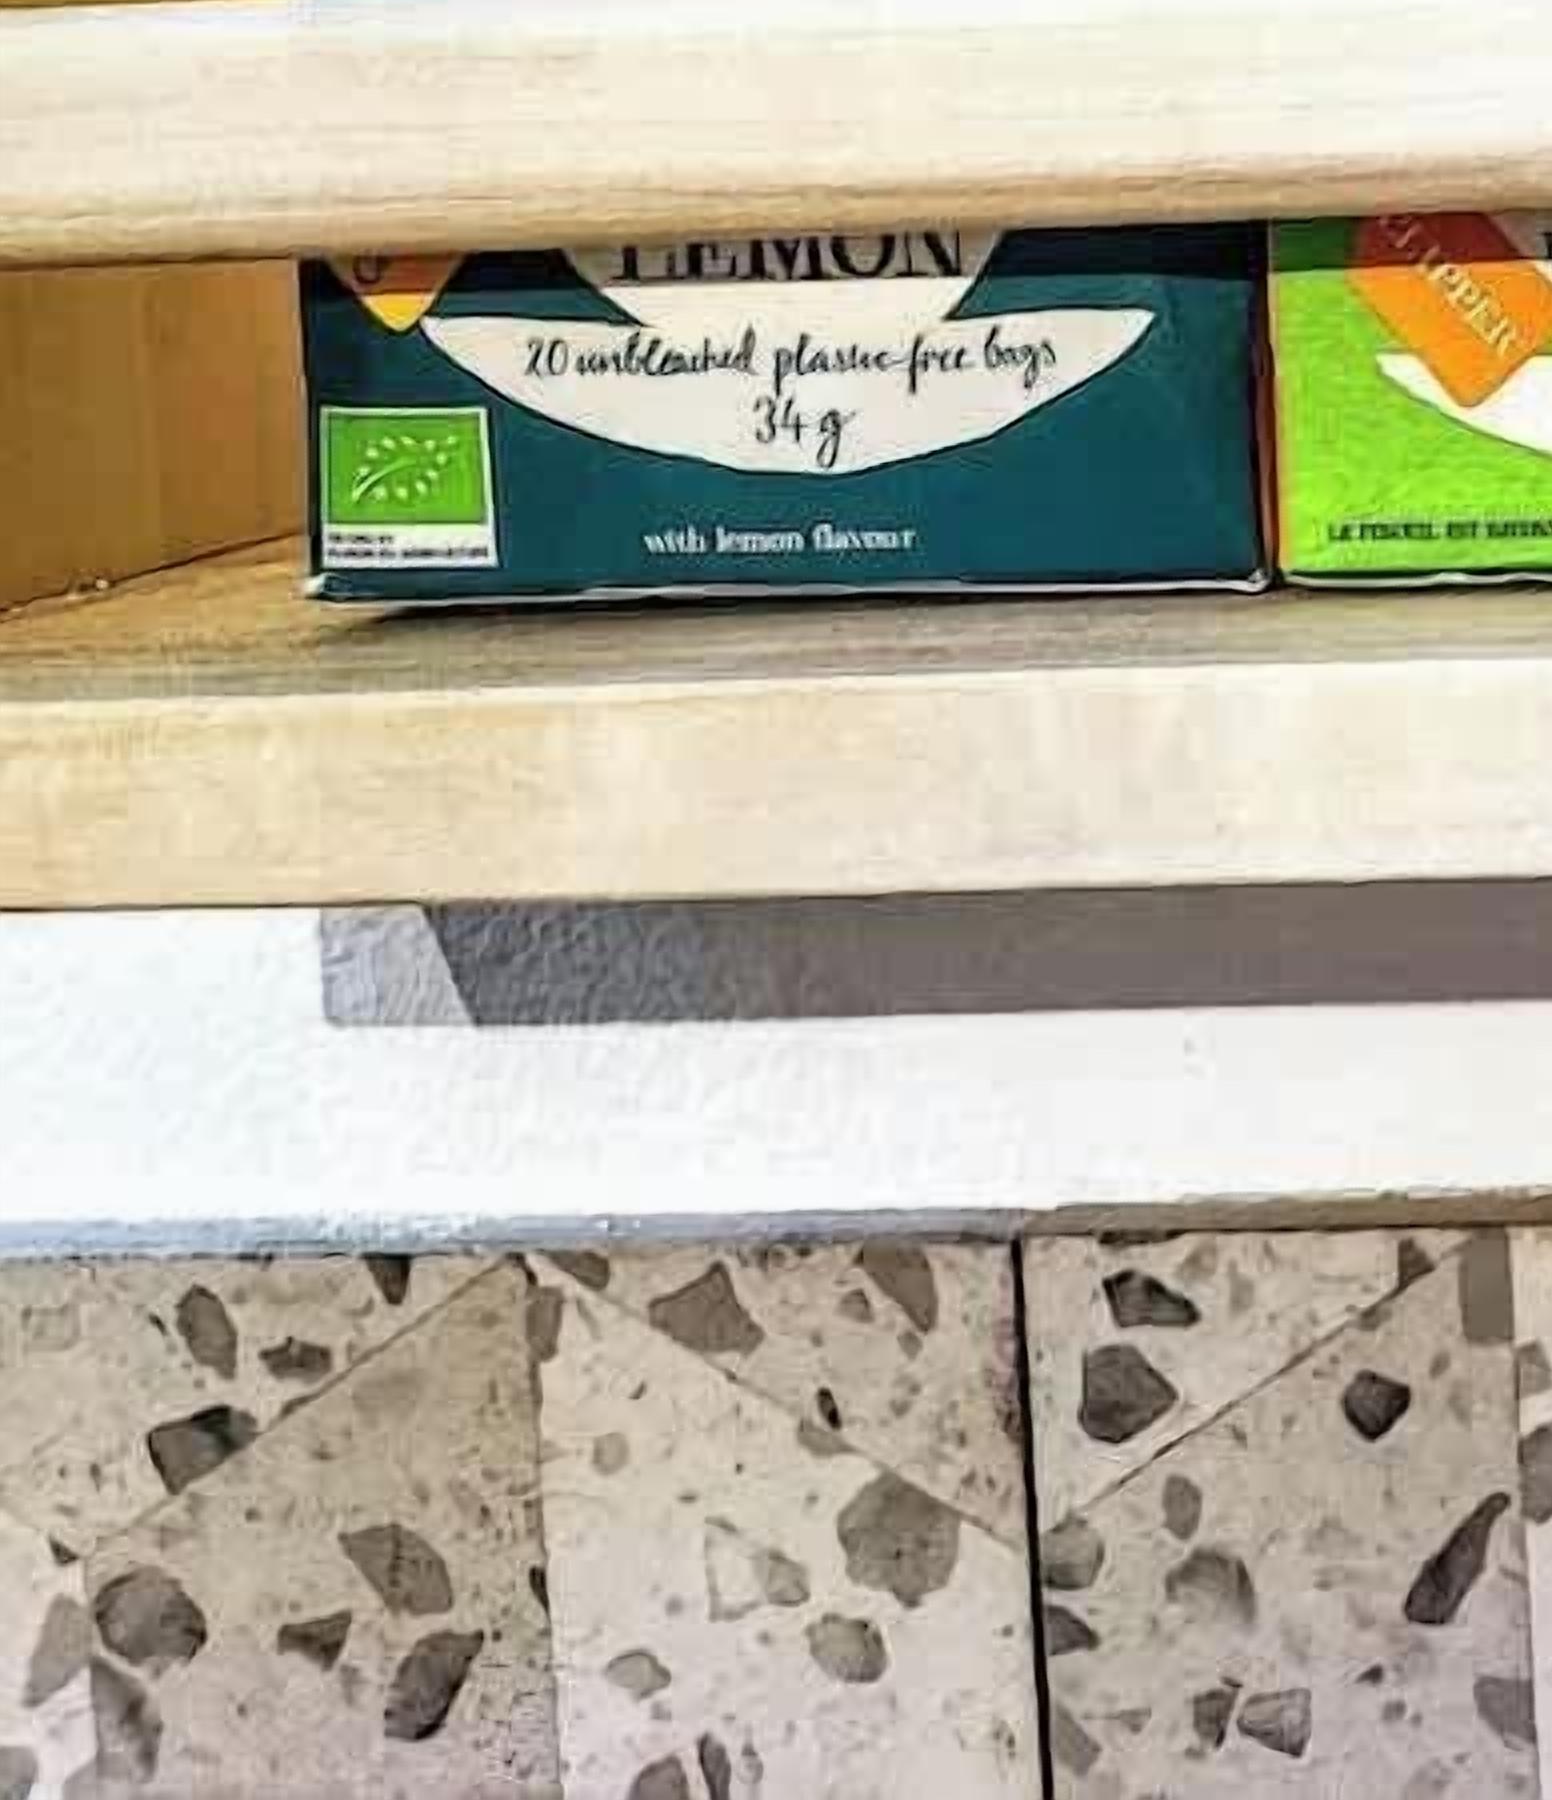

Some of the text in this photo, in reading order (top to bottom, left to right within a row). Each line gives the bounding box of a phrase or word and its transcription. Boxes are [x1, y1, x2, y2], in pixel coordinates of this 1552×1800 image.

[612, 230, 965, 281] LEMON
[525, 336, 570, 377] 20
[983, 325, 1057, 388] bags
[752, 395, 862, 468] 34 g
[642, 520, 917, 556] with lemon flavour
